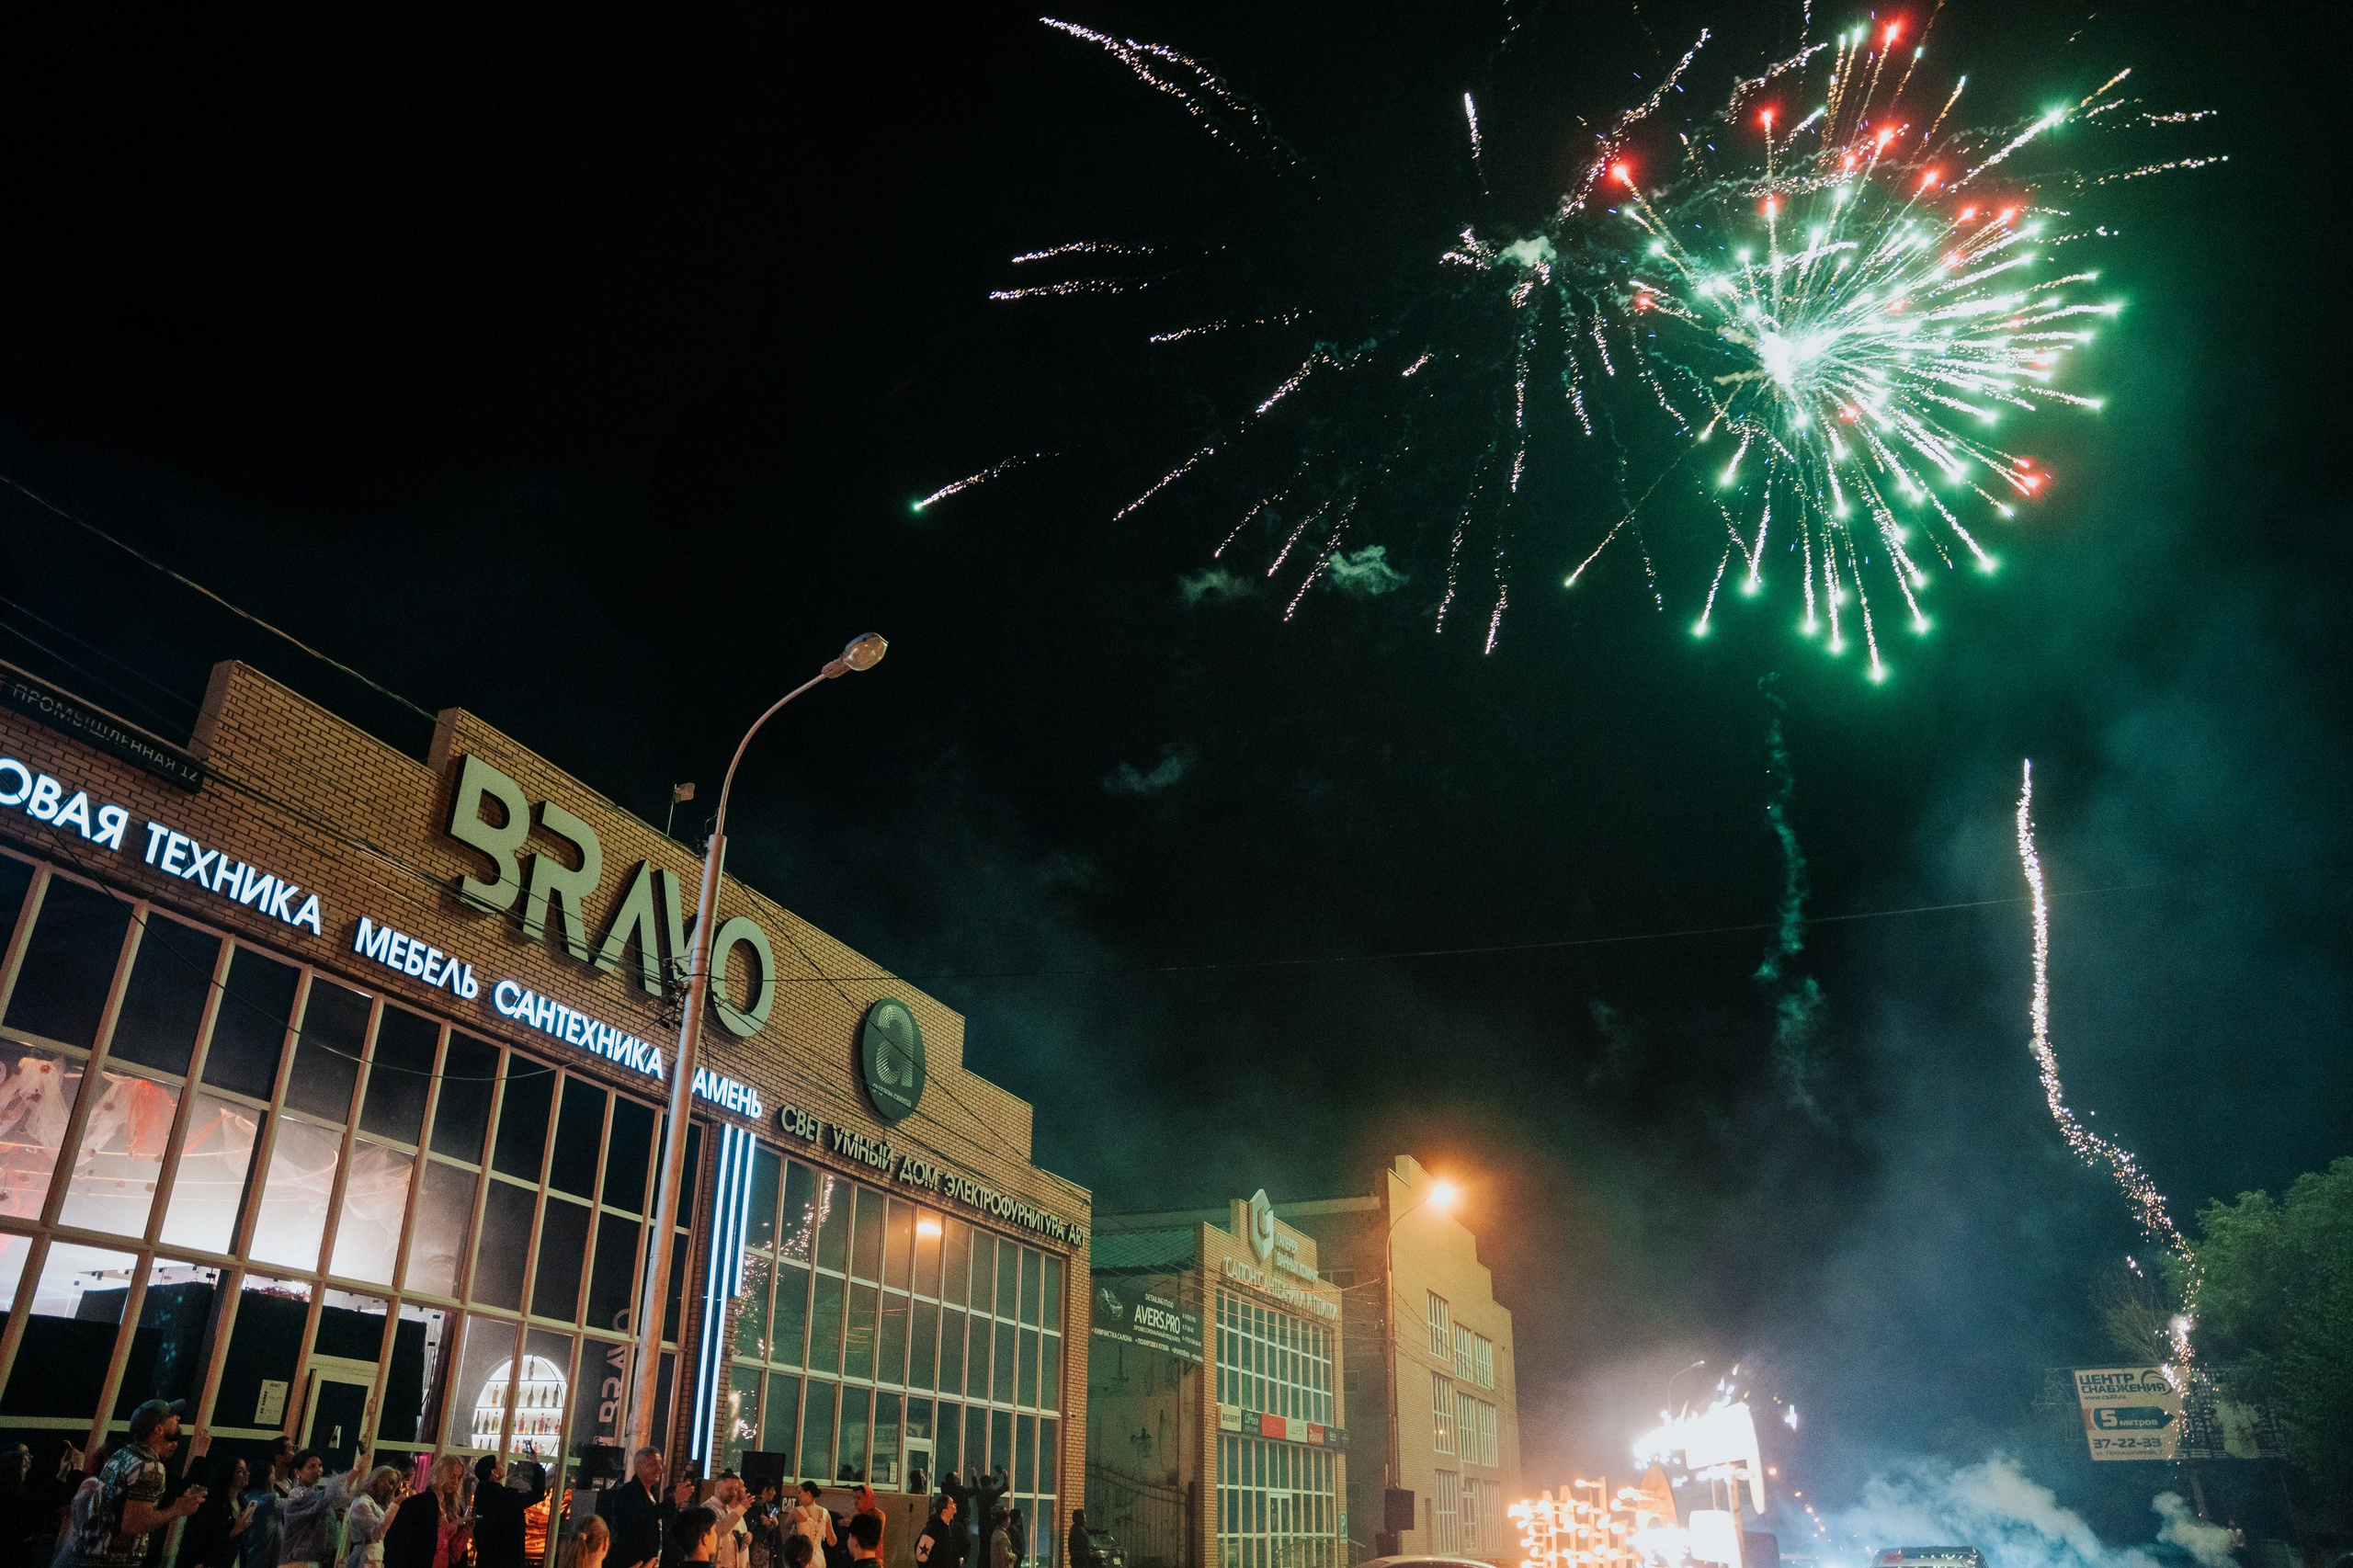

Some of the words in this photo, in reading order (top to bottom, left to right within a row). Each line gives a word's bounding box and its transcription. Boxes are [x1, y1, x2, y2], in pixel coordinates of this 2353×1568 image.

[450, 754, 776, 1037] BRAVO
[0, 757, 130, 851] ОВАЯ
[144, 822, 322, 936] ТЕХНИКА
[354, 916, 480, 1000] МЕБЕЛЬ
[493, 979, 665, 1080] САНТЕХНИКА
[691, 1066, 763, 1119] АМЕНЬ
[781, 1104, 824, 1143] СВЕТ
[832, 1124, 895, 1173] УМНЫЙ
[899, 1155, 939, 1191] ДОМ
[944, 1172, 1065, 1240] ЭЛЕКТРОФУРНИТУРА
[1223, 1256, 1257, 1285] САЛОН
[1134, 1304, 1180, 1335] AVERS.PRO
[2078, 1373, 2134, 1385] ЦЕНТР
[2081, 1382, 2166, 1393] СНАБЖЕНИЯ
[2100, 1409, 2118, 1427] 5
[2119, 1419, 2158, 1427] метров
[2093, 1437, 2162, 1449] 37-22-33
[781, 1496, 797, 1513] CAT
[1340, 1515, 1346, 1533] P
